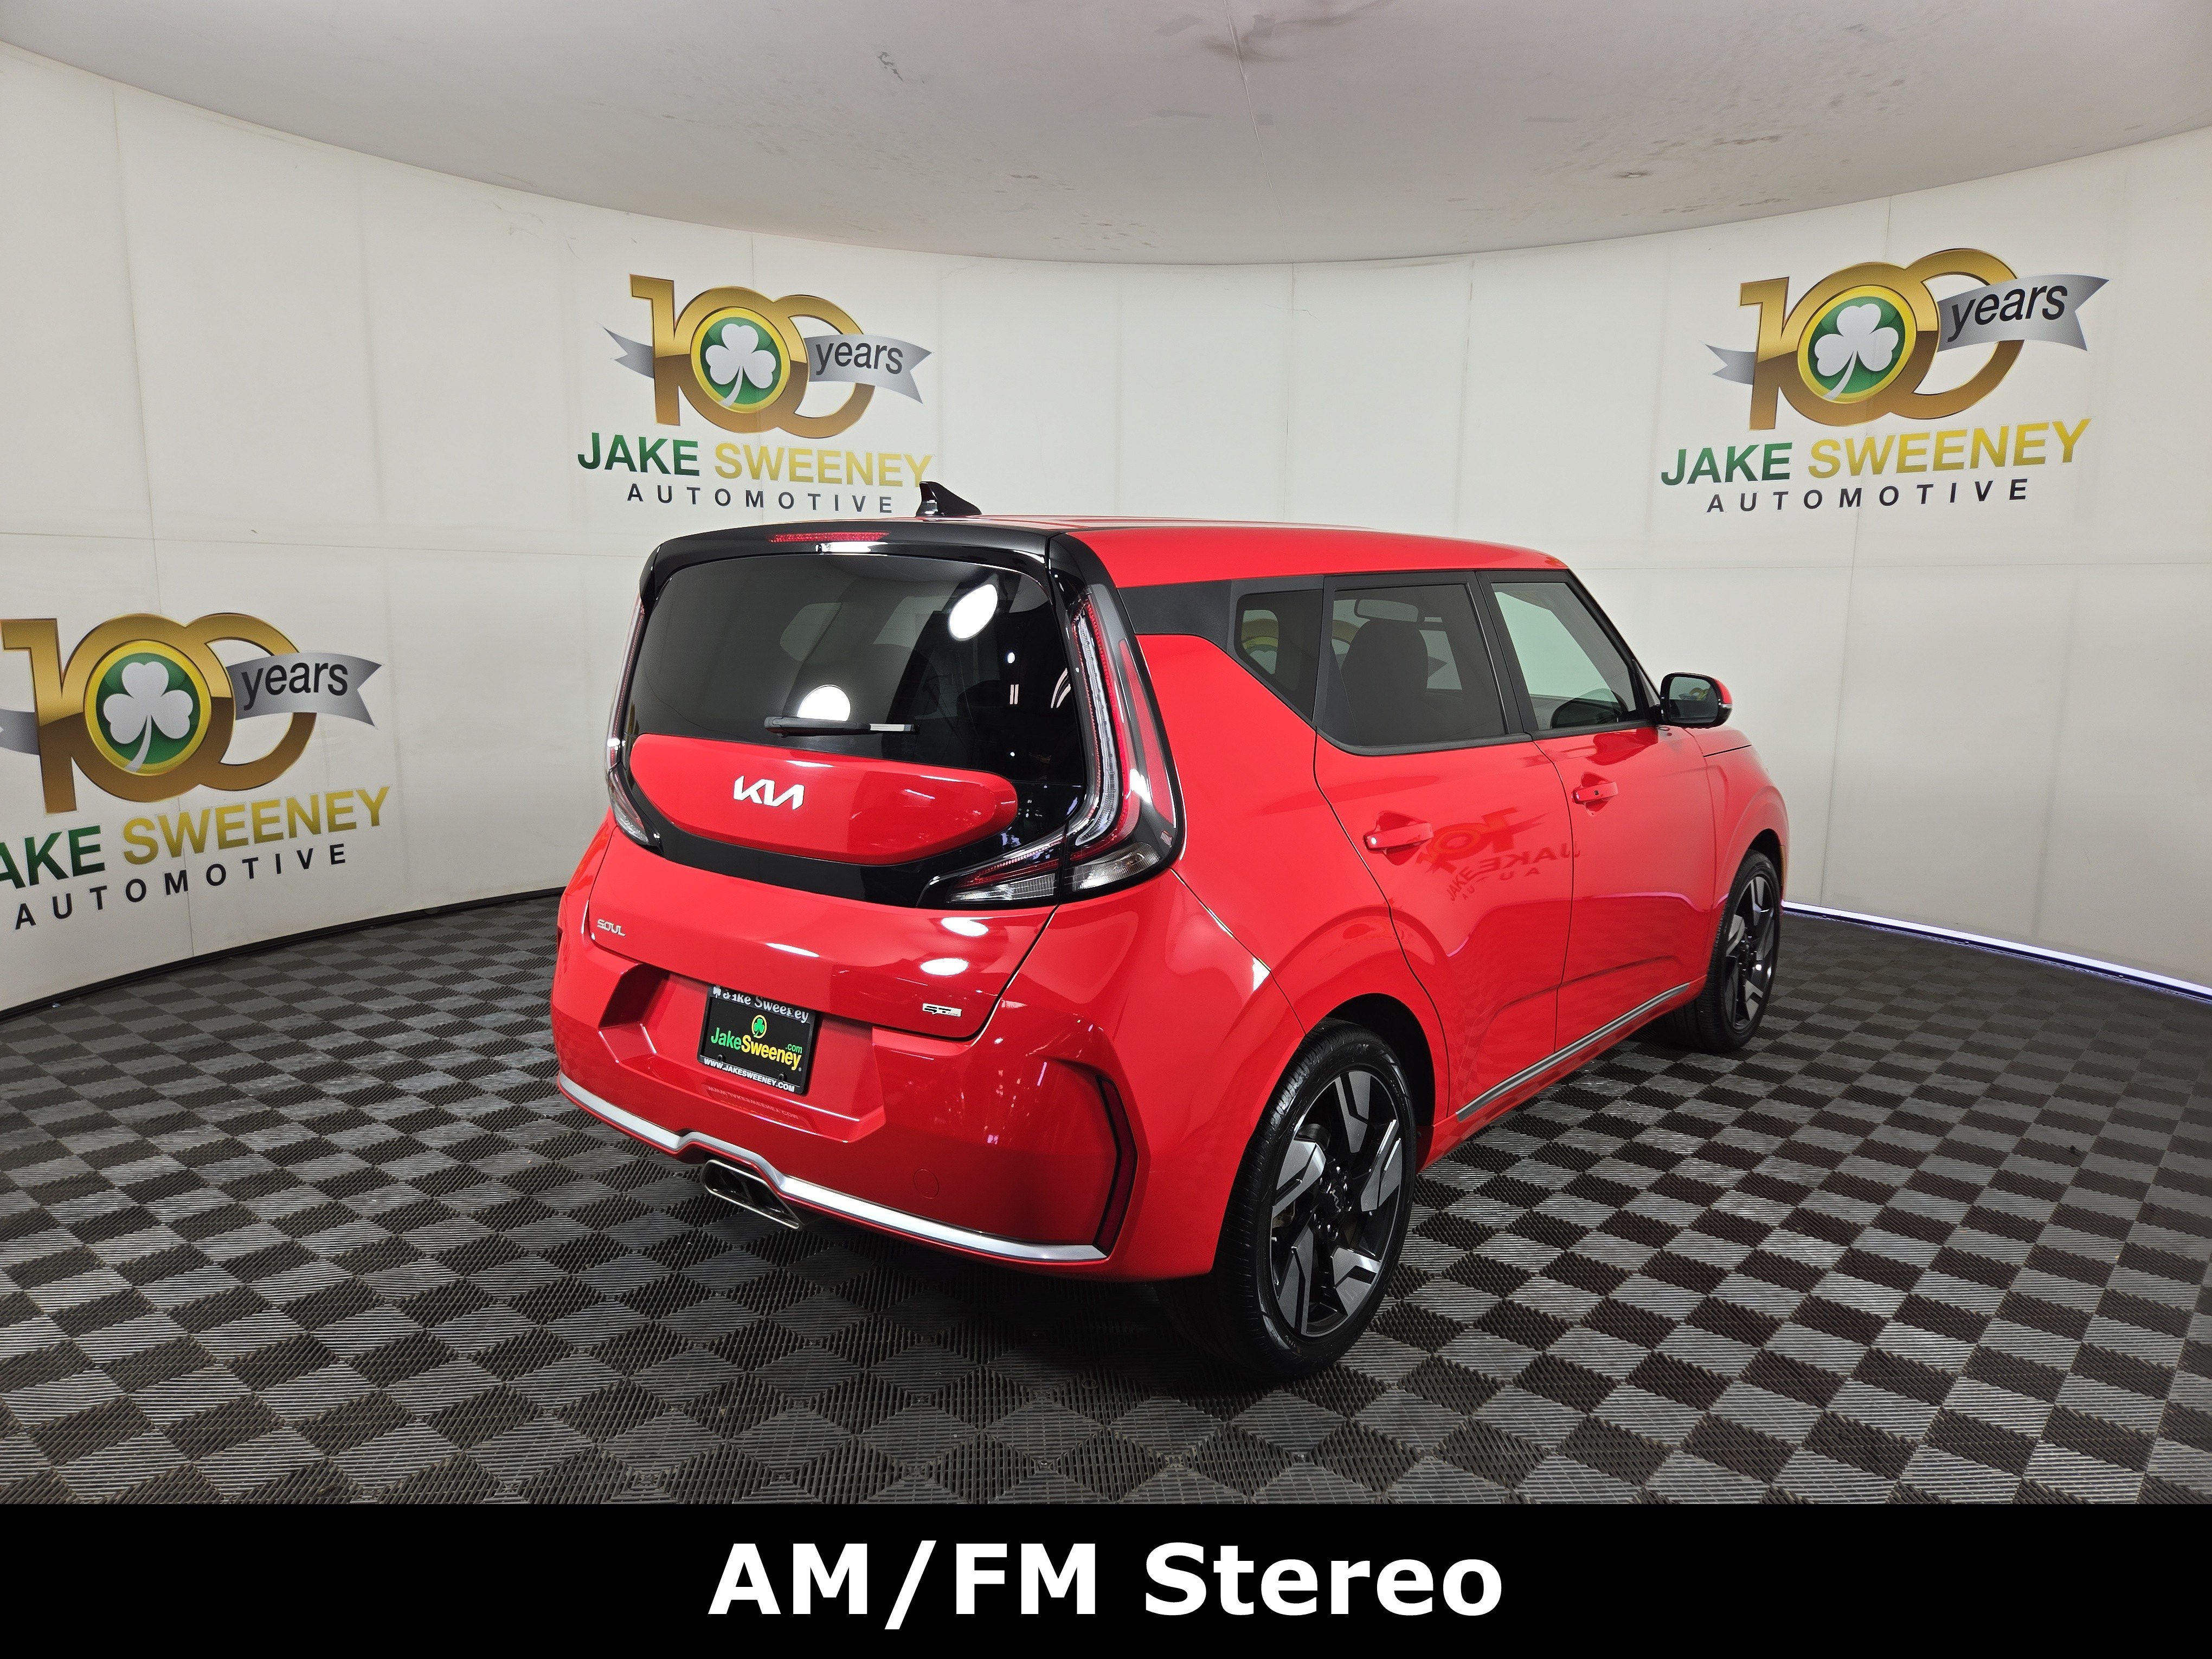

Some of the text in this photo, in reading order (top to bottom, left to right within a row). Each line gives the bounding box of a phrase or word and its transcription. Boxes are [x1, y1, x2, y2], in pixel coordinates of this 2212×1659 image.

[629, 274, 904, 439] 100 years
[1739, 248, 2068, 430] 100 years
[577, 432, 933, 487] JAKE SWEENEY
[1661, 418, 2092, 486] JAKE SWEENEY
[627, 483, 892, 513] AUTOMOTIVE
[1706, 478, 2028, 513] AUTOMOTIVE
[0, 613, 349, 813] 100 years
[733, 775, 805, 811] KIA
[0, 786, 390, 890] AKE SWEENEY
[15, 843, 346, 930] AUTOMOTIVE
[597, 918, 627, 937] SOUL
[754, 995, 809, 1024] Sweeney
[704, 1057, 795, 1092] WWW.JAKESWEENEY.COM
